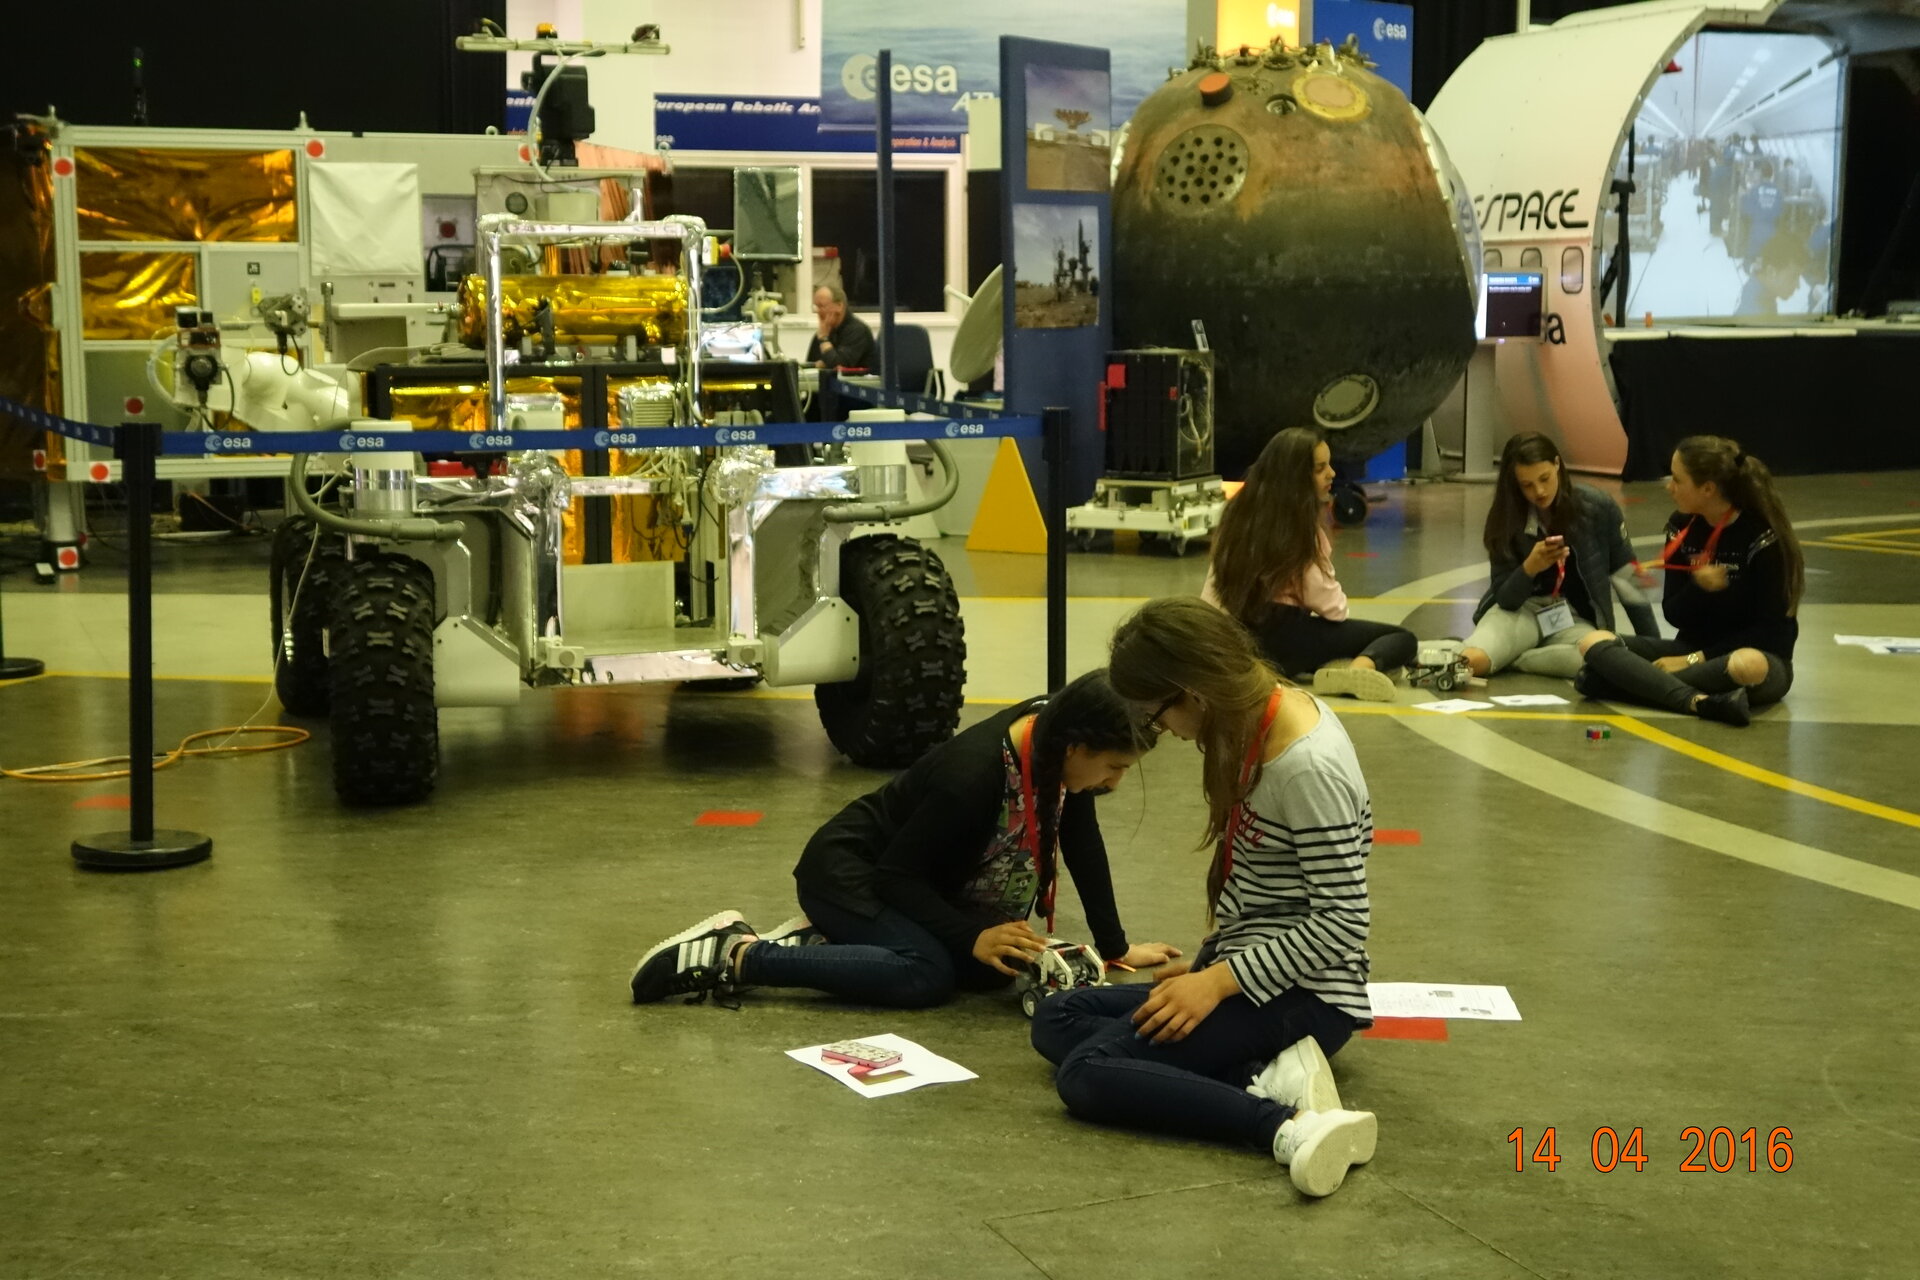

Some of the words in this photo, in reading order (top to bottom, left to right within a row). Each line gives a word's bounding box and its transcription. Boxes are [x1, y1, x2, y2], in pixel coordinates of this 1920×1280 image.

[890, 63, 957, 93] esa
[654, 99, 727, 115] uropean
[731, 101, 795, 115] Robotic
[1474, 188, 1589, 233] SPACE
